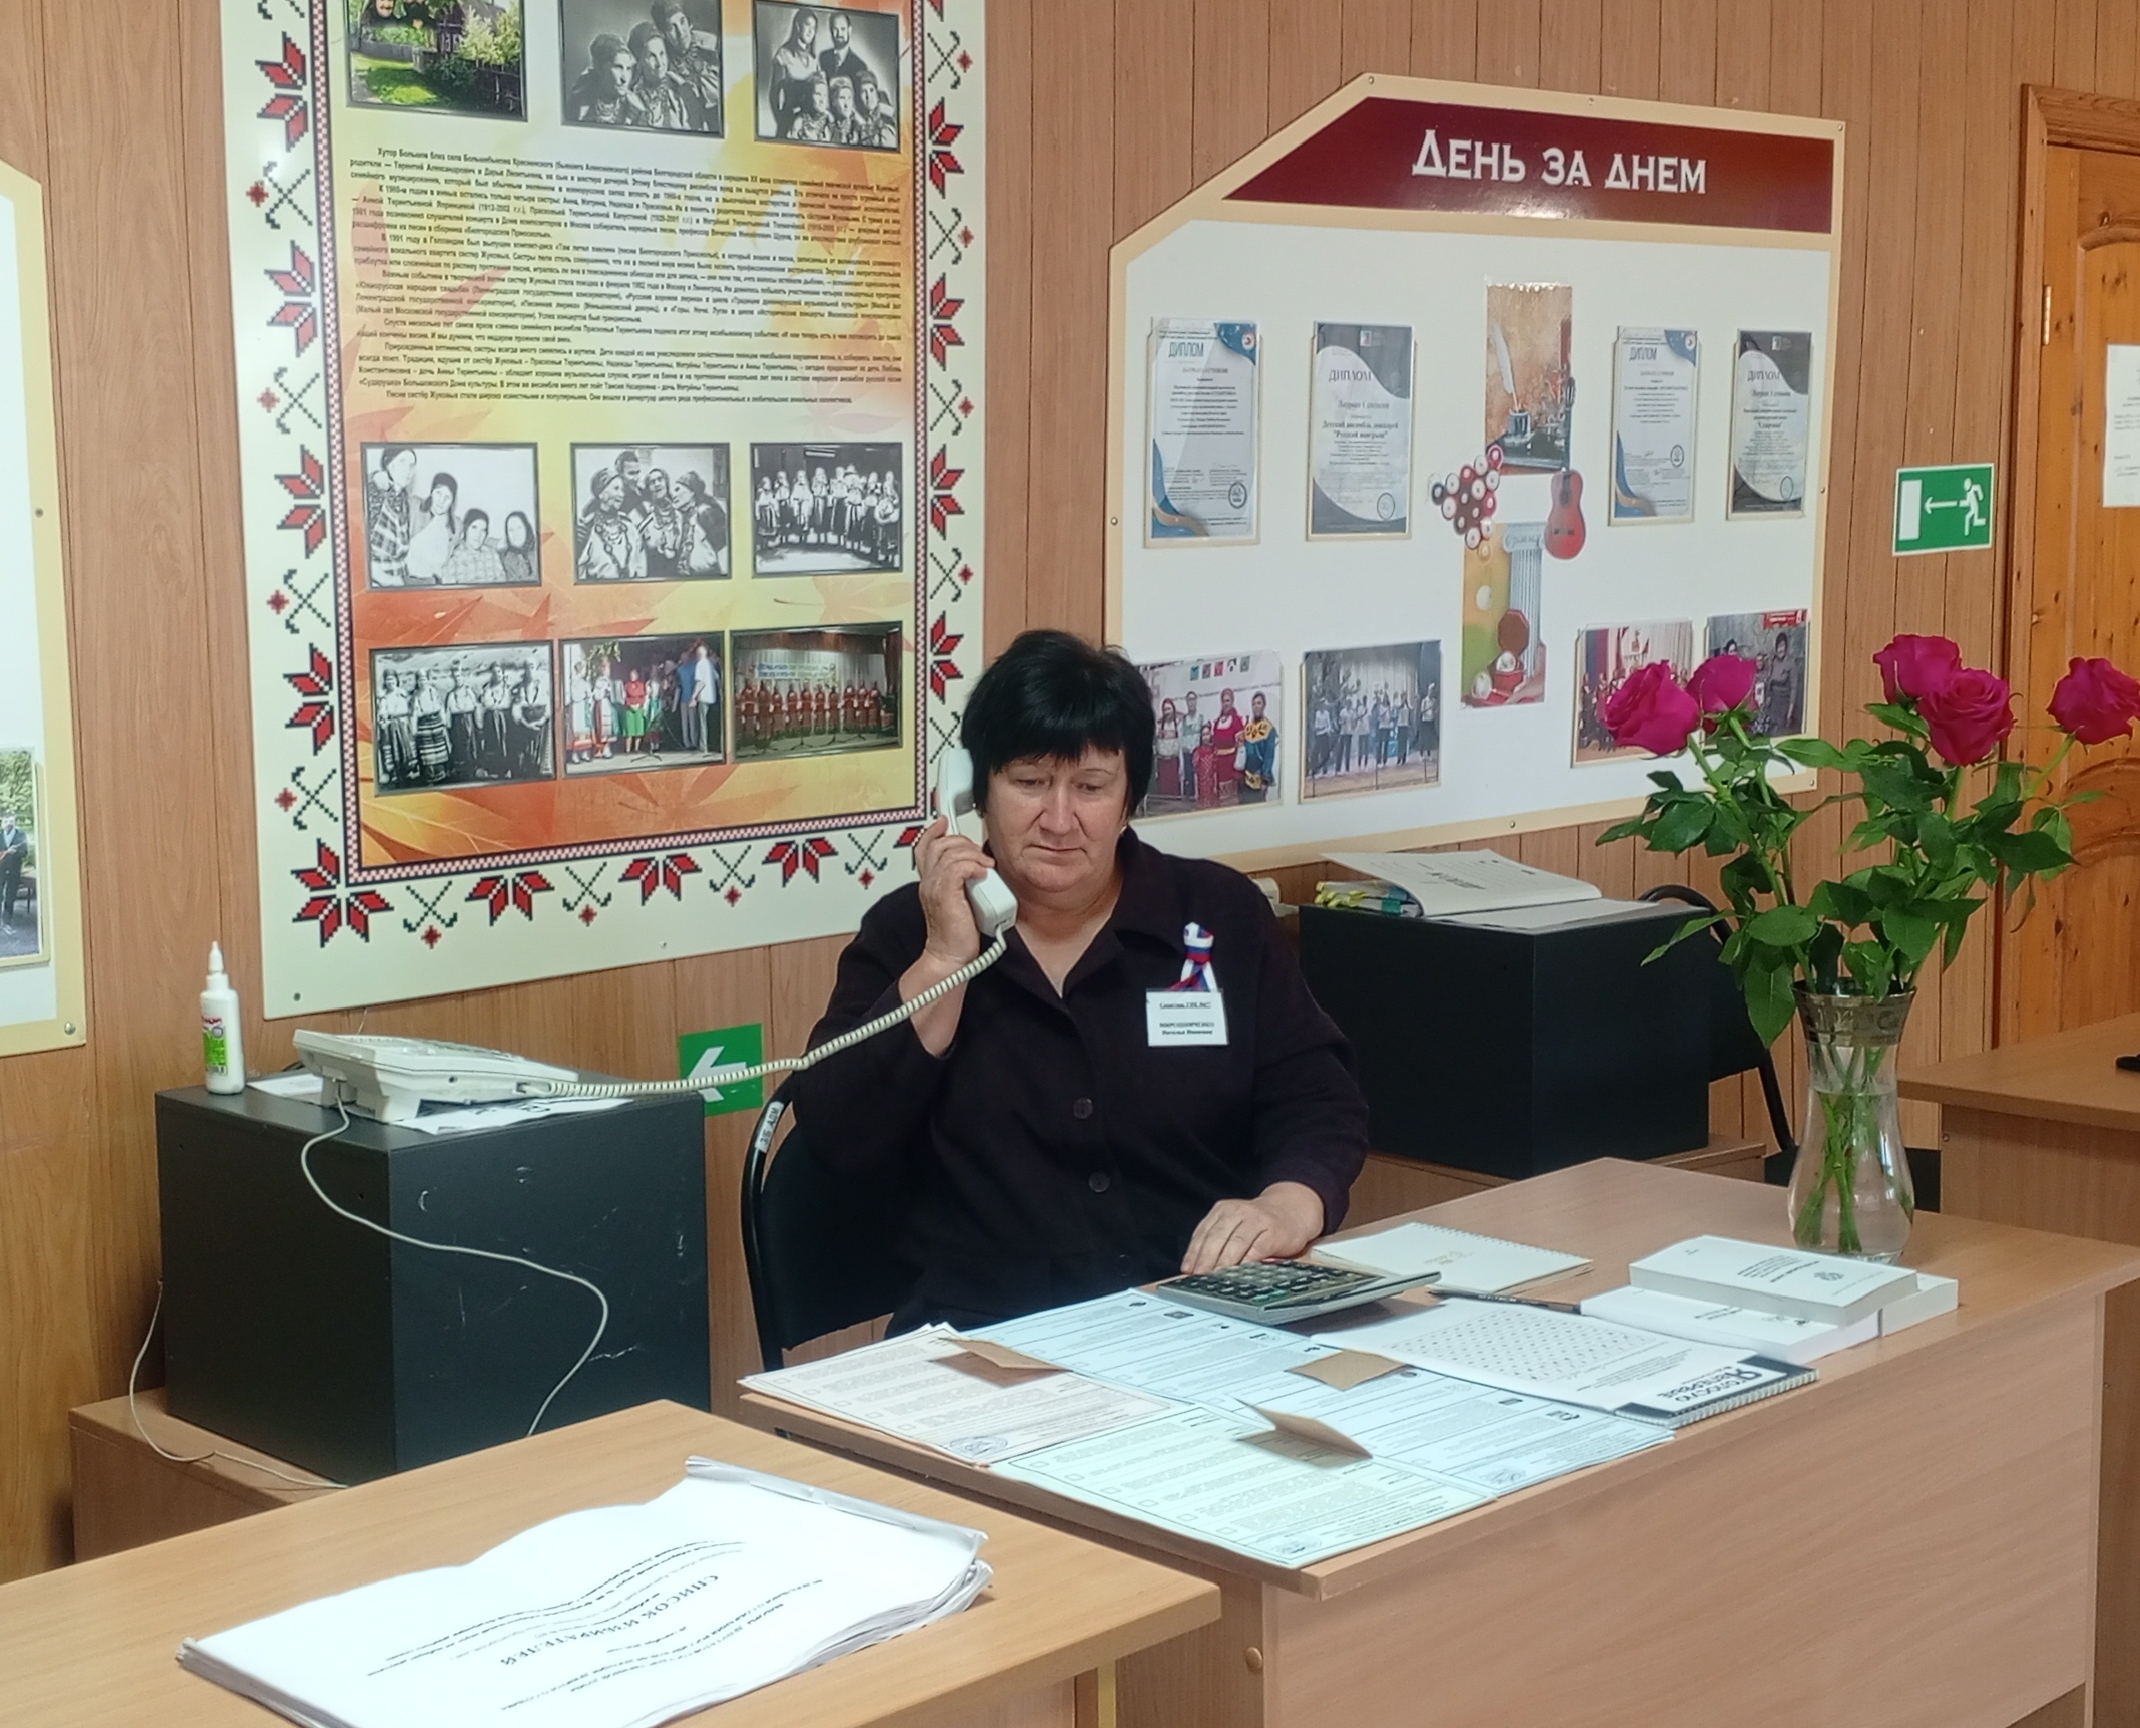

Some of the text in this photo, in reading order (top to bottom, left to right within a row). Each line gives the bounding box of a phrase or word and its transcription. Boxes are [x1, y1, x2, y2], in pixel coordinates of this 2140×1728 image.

[1411, 129, 1707, 194] ДЕНЬ ЗА ДНЕМ
[1168, 341, 1204, 358] ДИПЛОМ
[1629, 346, 1658, 361] ДИПЛОМ
[1329, 369, 1372, 382] ДИПЛОМ
[1747, 370, 1781, 382] ДИПЛОМ
[643, 1573, 719, 1619] СПИСОК
